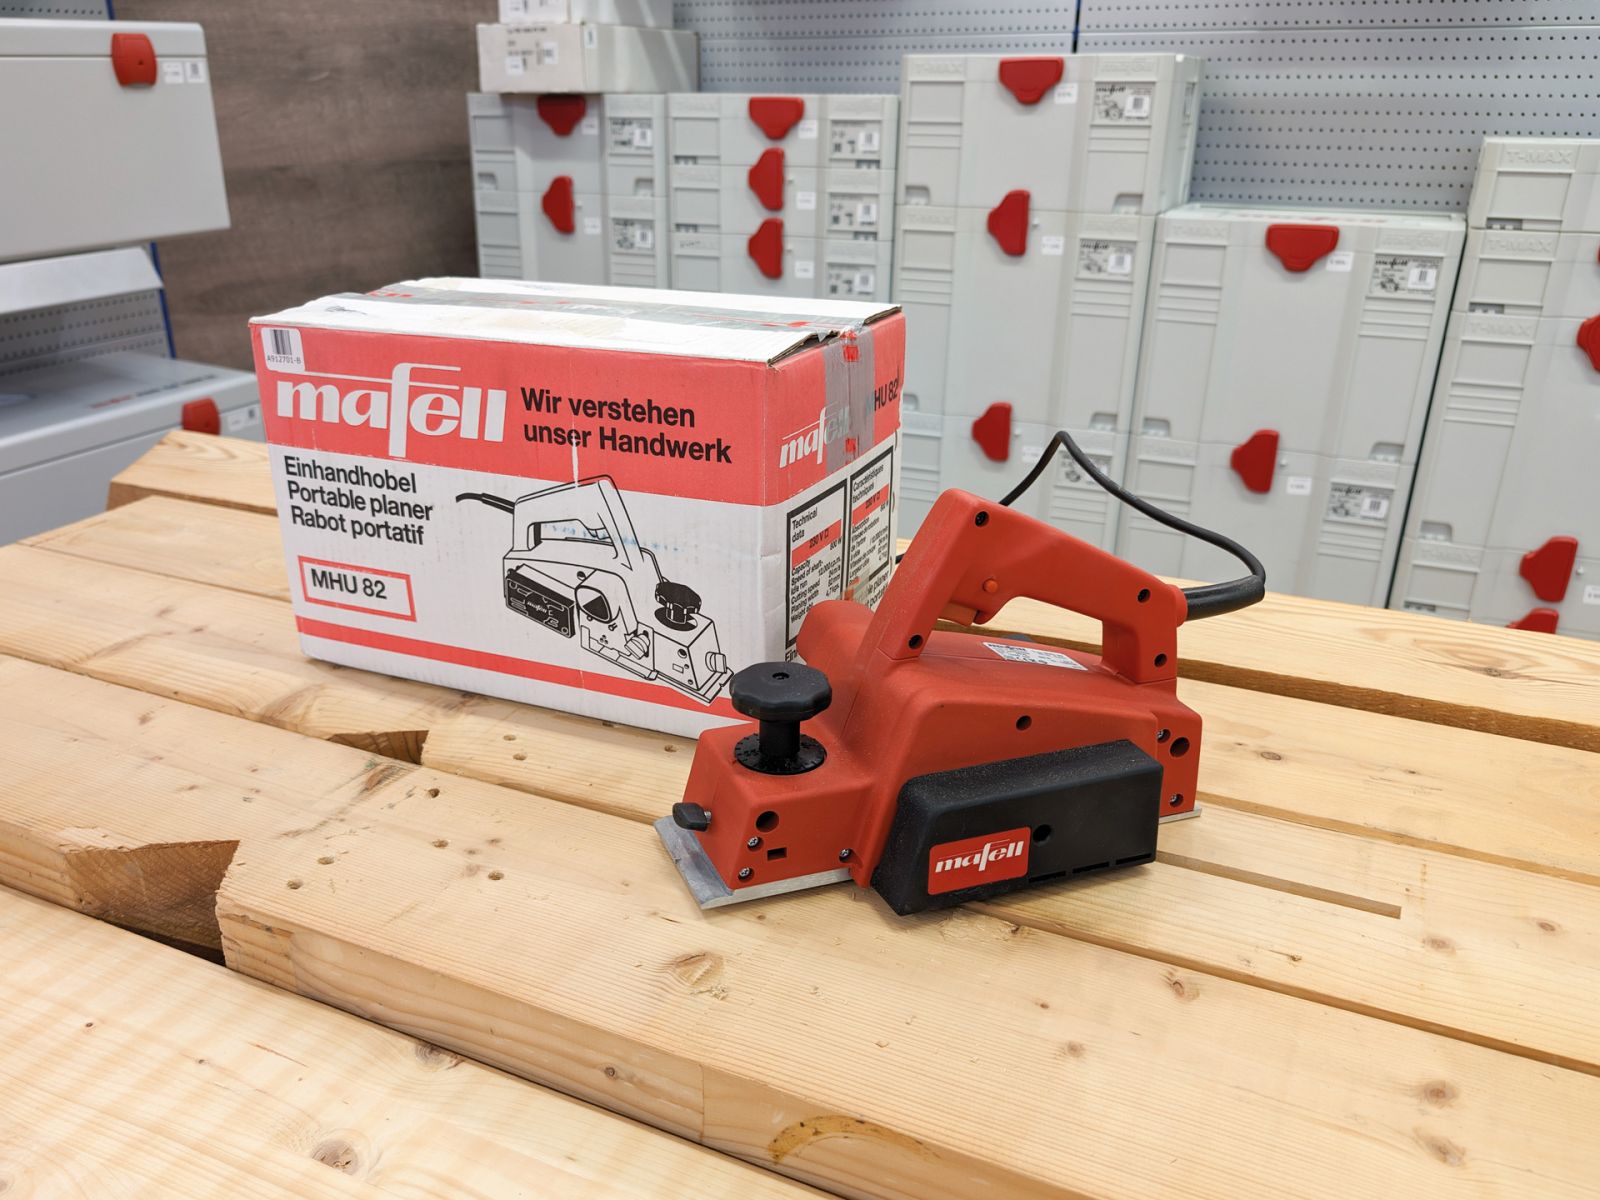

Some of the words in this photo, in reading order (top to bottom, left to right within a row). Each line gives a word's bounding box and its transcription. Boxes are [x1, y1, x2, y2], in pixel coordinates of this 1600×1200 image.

[1506, 151, 1572, 164] T-MAX
[1488, 238, 1552, 251] T-MAX
[276, 362, 507, 458] mafell
[520, 386, 562, 414] Wir
[568, 397, 696, 428] verstehen
[523, 423, 592, 448] unser
[599, 426, 733, 464] Handwerk
[284, 455, 417, 493] Einhandhobel
[287, 480, 367, 511] Portable
[370, 494, 434, 521] planer
[291, 505, 348, 533] Rabot
[350, 519, 425, 545] portatif
[792, 506, 818, 530] Technical
[792, 529, 805, 543] data
[809, 533, 819, 549] 230
[792, 560, 811, 577] Capacity
[792, 570, 806, 586] Speed
[311, 568, 359, 594] MHU
[362, 578, 388, 599] 82
[791, 590, 808, 605] Cutting
[808, 578, 820, 593] speed
[800, 580, 808, 589] run
[791, 599, 807, 614] Planing
[808, 589, 819, 602] width
[791, 607, 806, 624] Weight
[935, 839, 1024, 873] mafell
